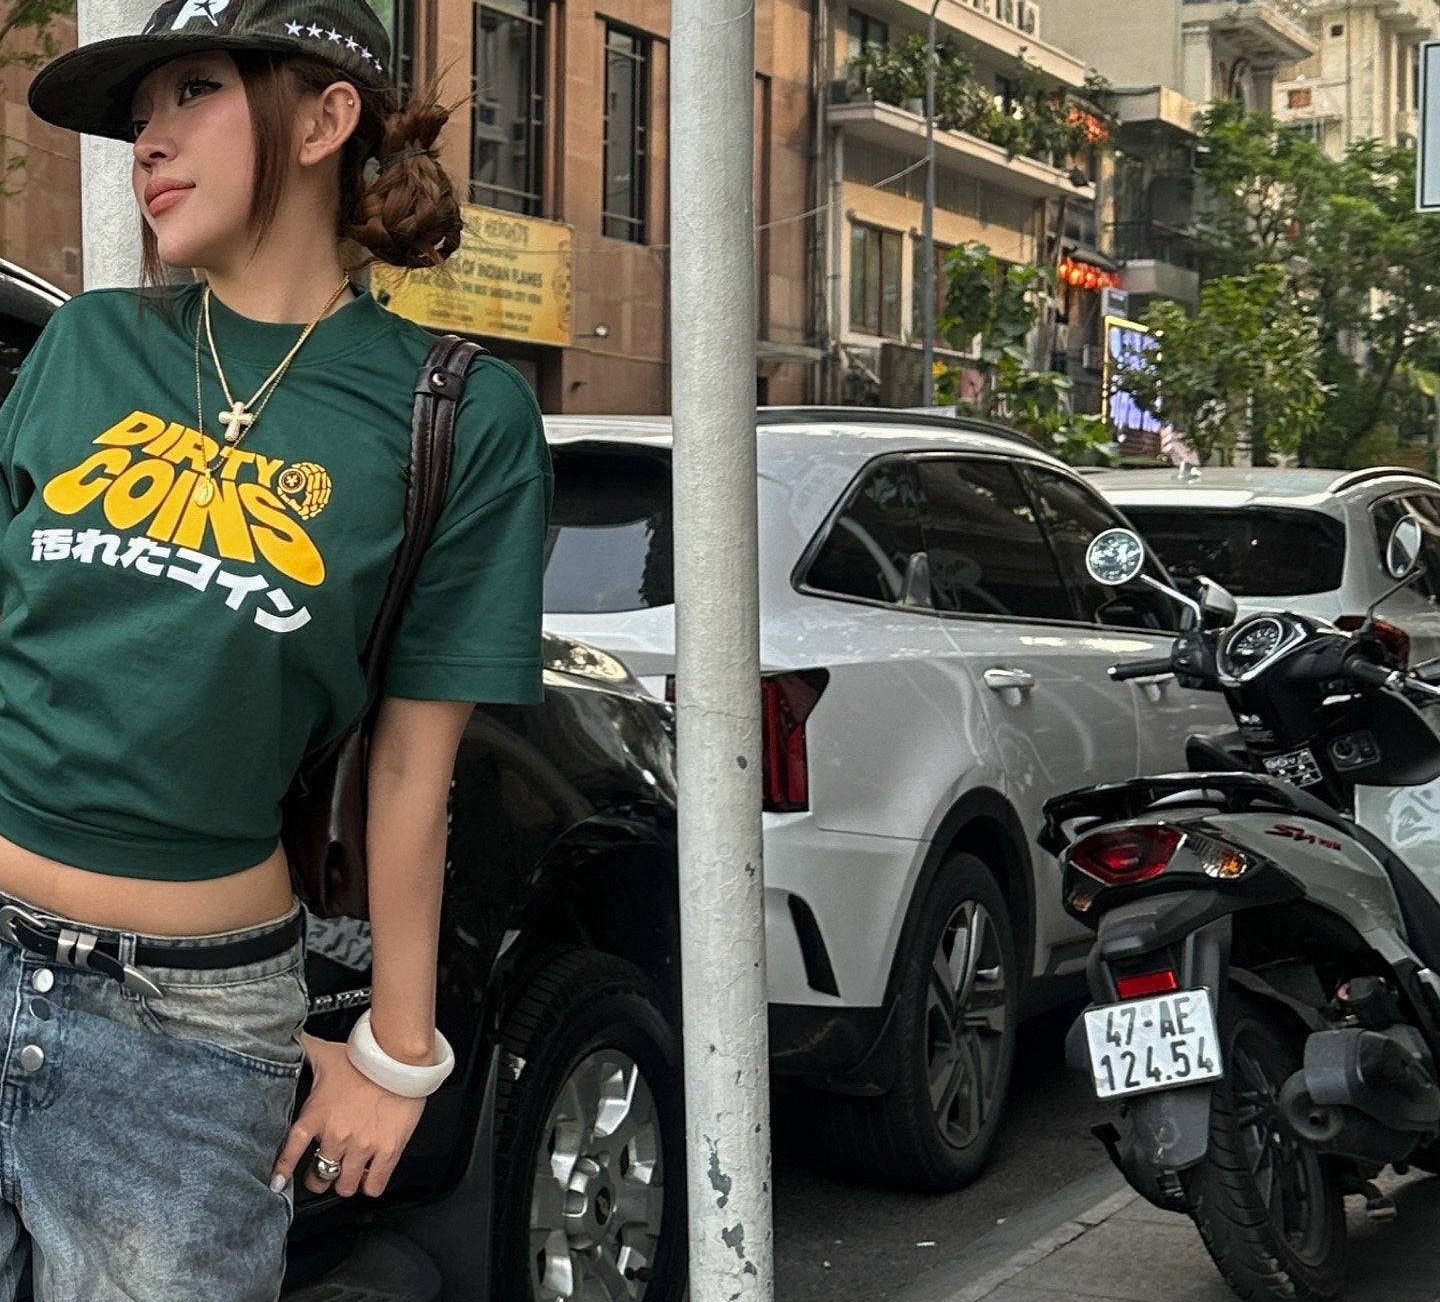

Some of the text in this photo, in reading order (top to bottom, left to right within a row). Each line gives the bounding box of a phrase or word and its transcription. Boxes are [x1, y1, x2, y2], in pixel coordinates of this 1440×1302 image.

[92, 410, 284, 487] DIRTY
[42, 447, 327, 587] COINS
[31, 528, 312, 633] 汚れたコイン
[1100, 1036, 1214, 1091] 124.54
